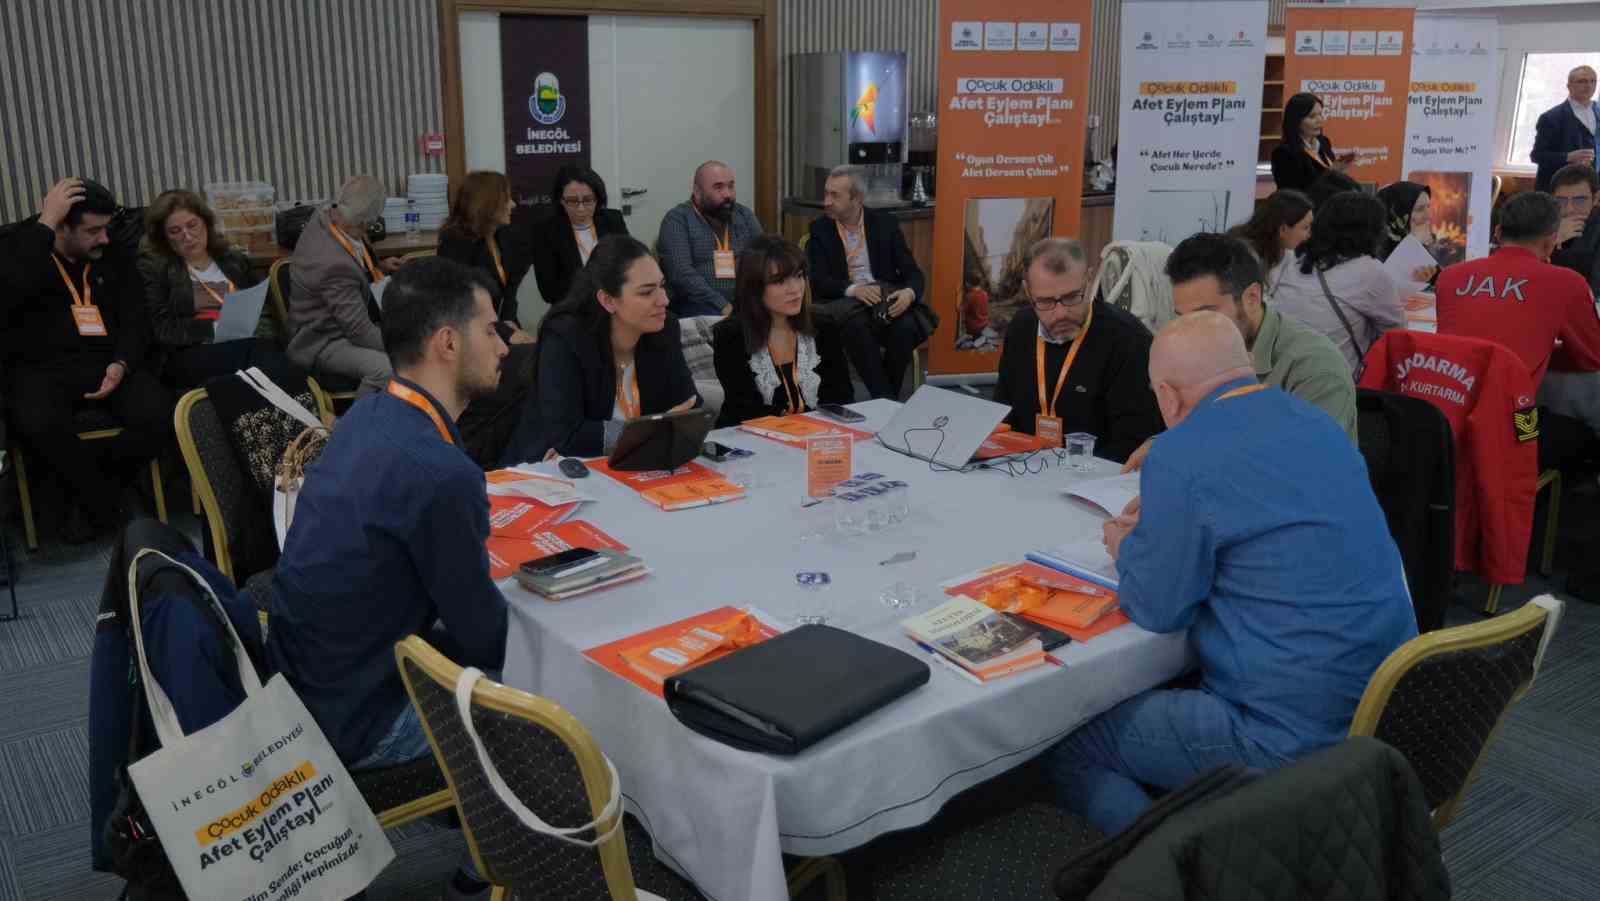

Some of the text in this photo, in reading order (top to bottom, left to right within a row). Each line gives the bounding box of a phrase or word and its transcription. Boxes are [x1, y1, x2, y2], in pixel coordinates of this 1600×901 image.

[966, 79, 1054, 93] Çocuk Odaklı
[949, 95, 1073, 112] Afet Eylem Planı
[1131, 98, 1246, 112] Afet Eylem Planı
[1408, 95, 1423, 105] fet
[1425, 95, 1456, 106] Eylem
[527, 127, 570, 141] İNEGÖL
[516, 141, 581, 155] BELEDİYESİ
[1151, 150, 1171, 160] Afet
[1456, 275, 1529, 302] JAK
[1410, 380, 1466, 406] KURTARMA
[172, 722, 304, 812] İNEGÖL BELEDİYESİ
[207, 769, 307, 841] Çocuk Odaklı
[200, 836, 243, 871] Afet
[242, 800, 293, 845] Eylem
[292, 773, 334, 810] Planı
[304, 827, 353, 864] Çocuğun
